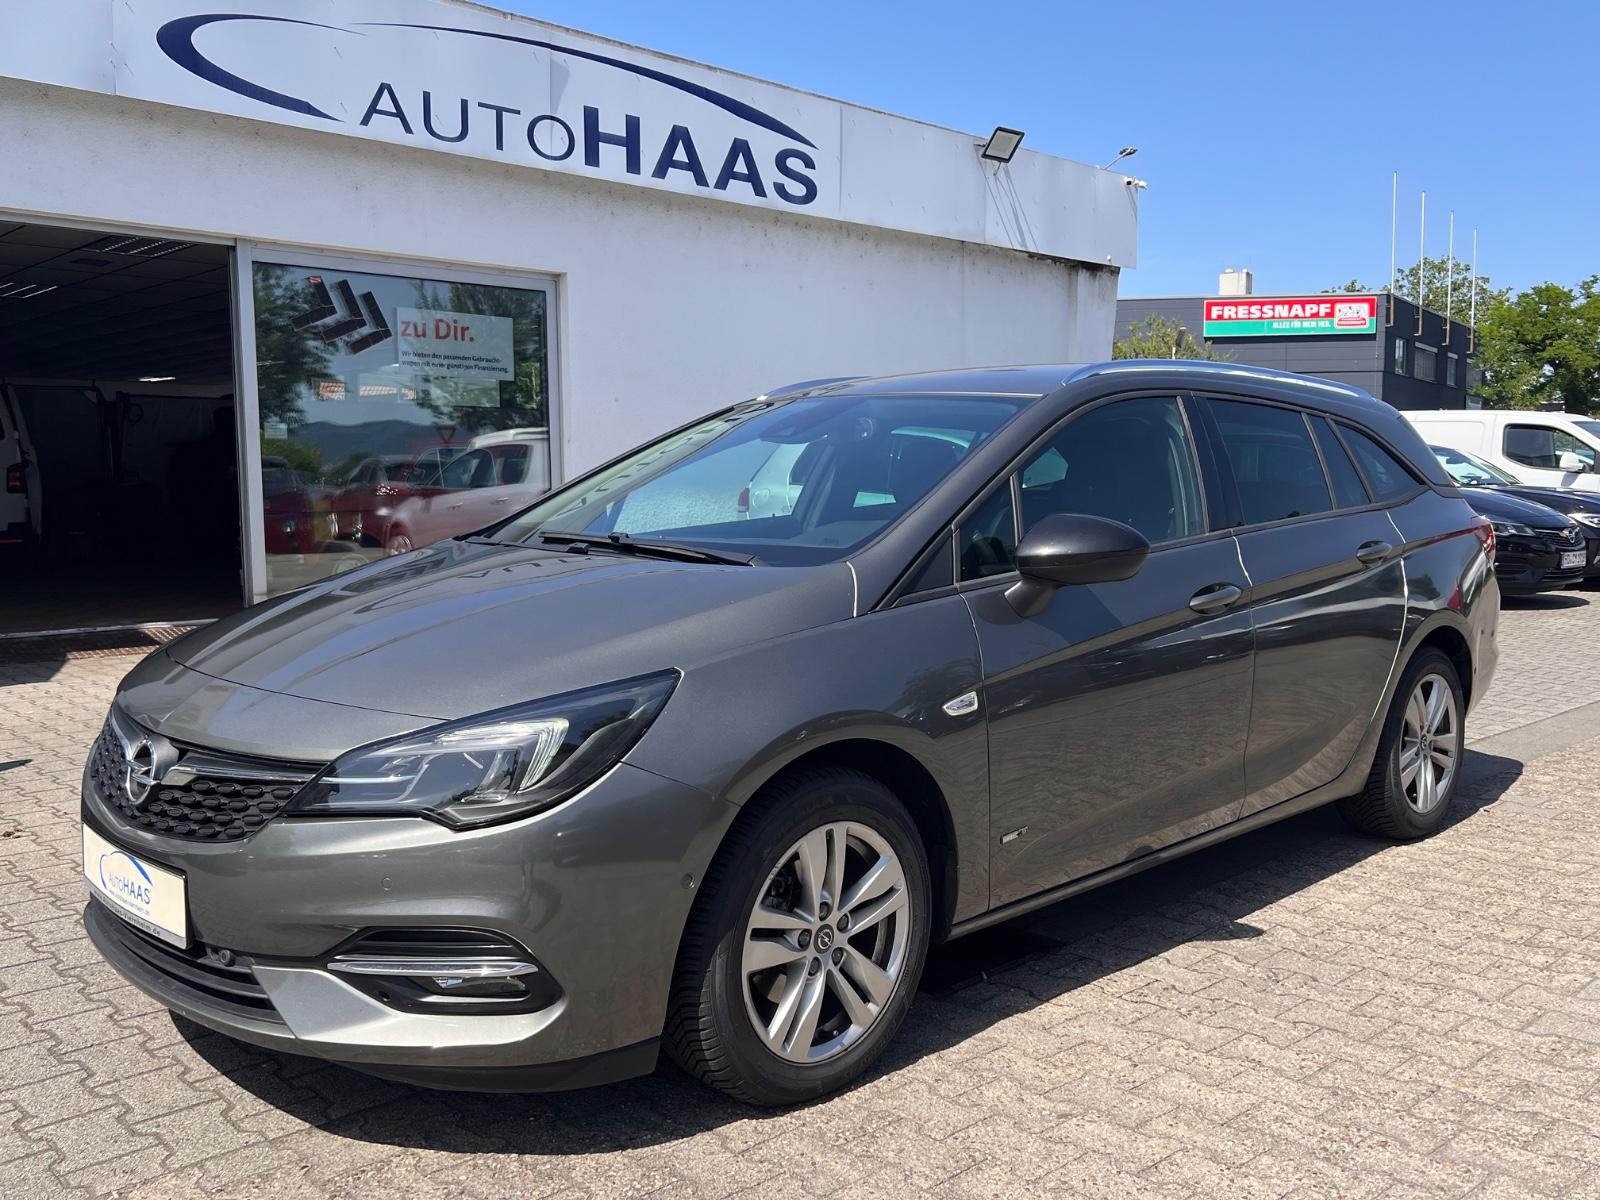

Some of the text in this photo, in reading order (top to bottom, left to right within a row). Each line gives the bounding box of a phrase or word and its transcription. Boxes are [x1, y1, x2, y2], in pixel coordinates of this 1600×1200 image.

[1211, 303, 1332, 320] FRESSNAPF
[401, 318, 475, 342] zu Dir.
[1272, 320, 1290, 329] ALLES
[431, 352, 443, 360] den
